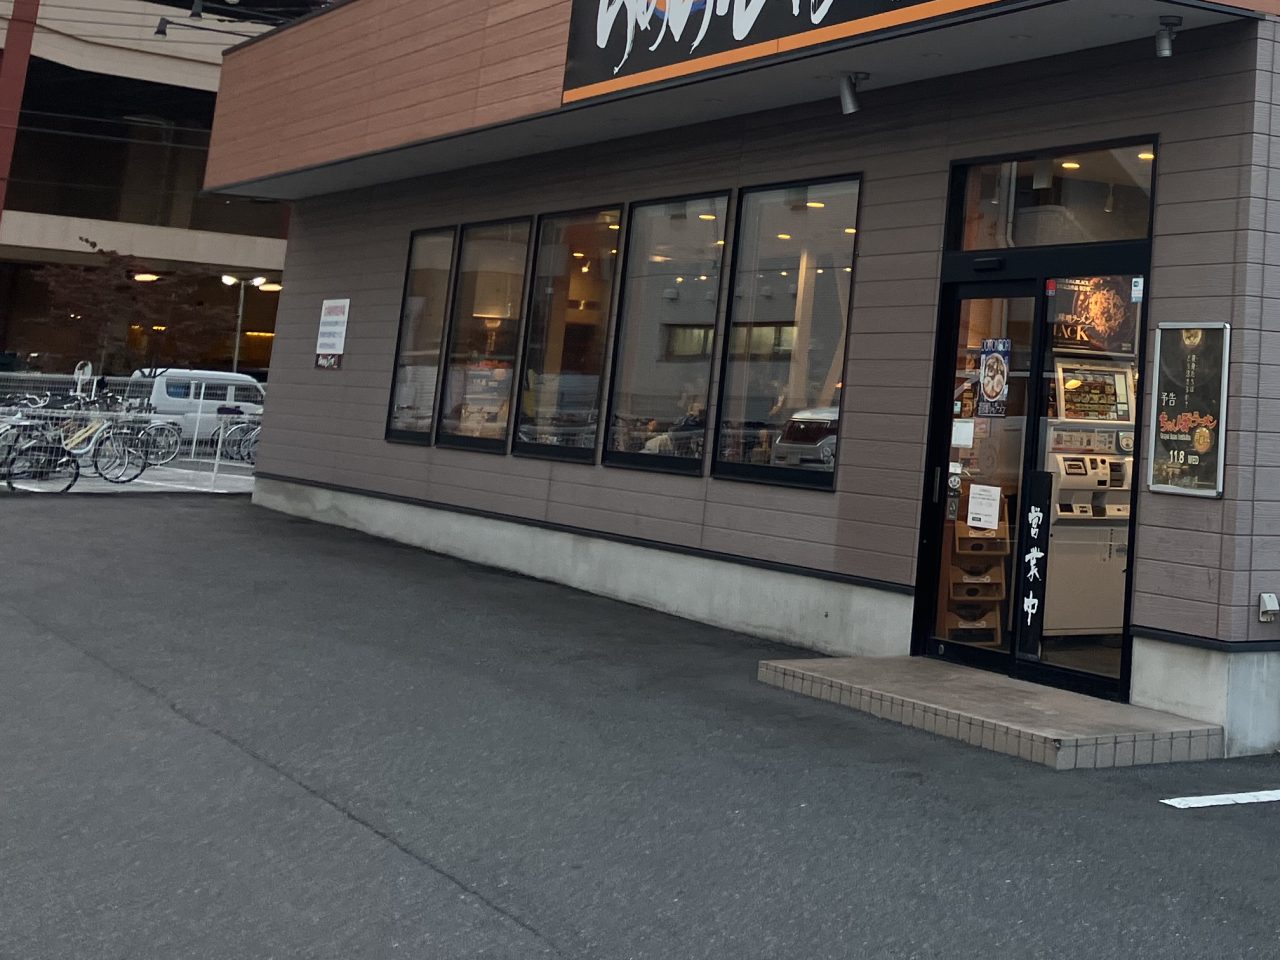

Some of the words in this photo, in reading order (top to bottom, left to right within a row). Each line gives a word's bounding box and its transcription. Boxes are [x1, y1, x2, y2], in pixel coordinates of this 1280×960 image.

[1161, 392, 1177, 407] 予告
[1023, 505, 1045, 626] 営業中
